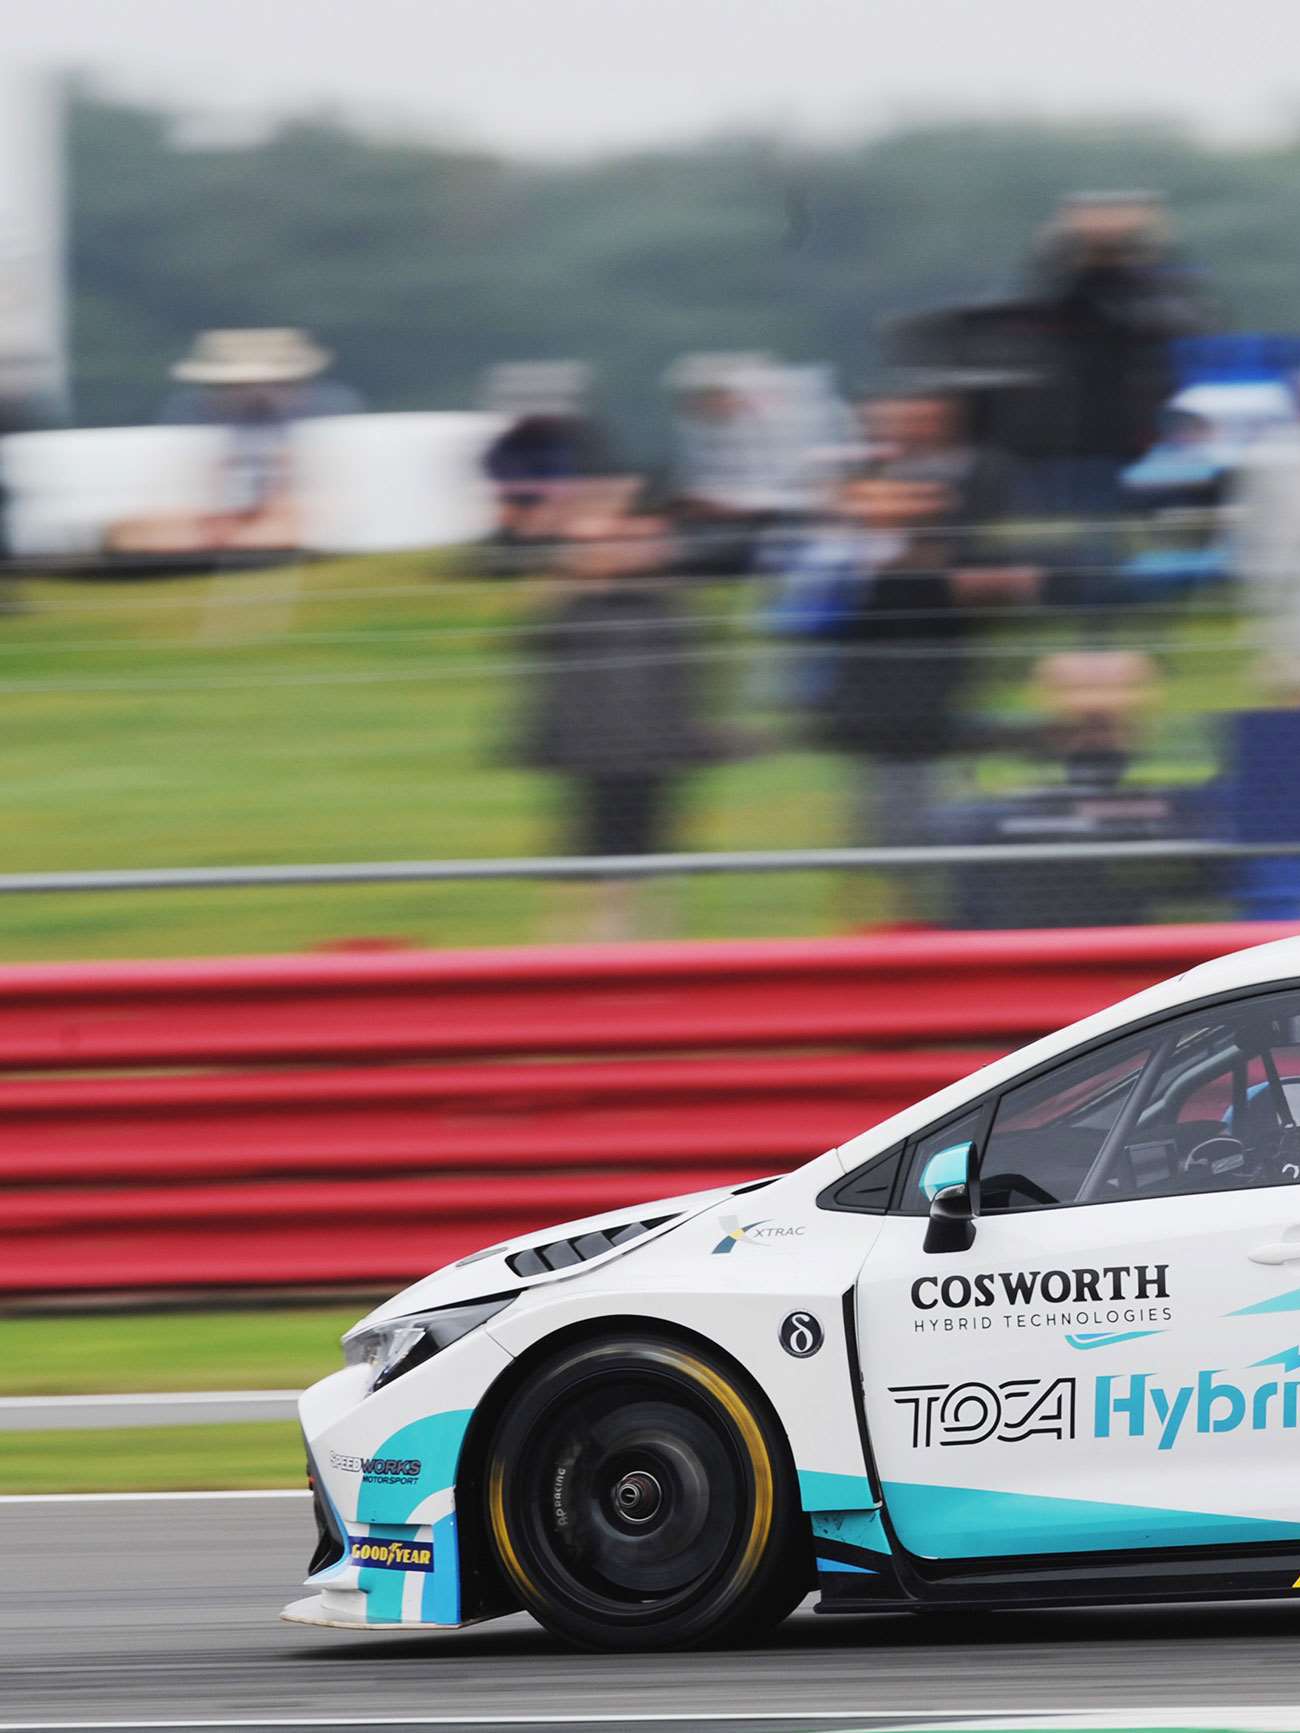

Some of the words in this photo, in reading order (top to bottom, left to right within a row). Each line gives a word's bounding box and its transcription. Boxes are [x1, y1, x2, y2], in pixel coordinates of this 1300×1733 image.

[753, 1226, 806, 1238] XTRAC
[910, 1264, 1170, 1310] COSWORTH
[914, 1316, 992, 1333] HYBRID
[1003, 1307, 1172, 1329] TECHNOLOGIES
[329, 1449, 421, 1476] SPEEDWORKS
[362, 1475, 419, 1485] MOTORSPORT
